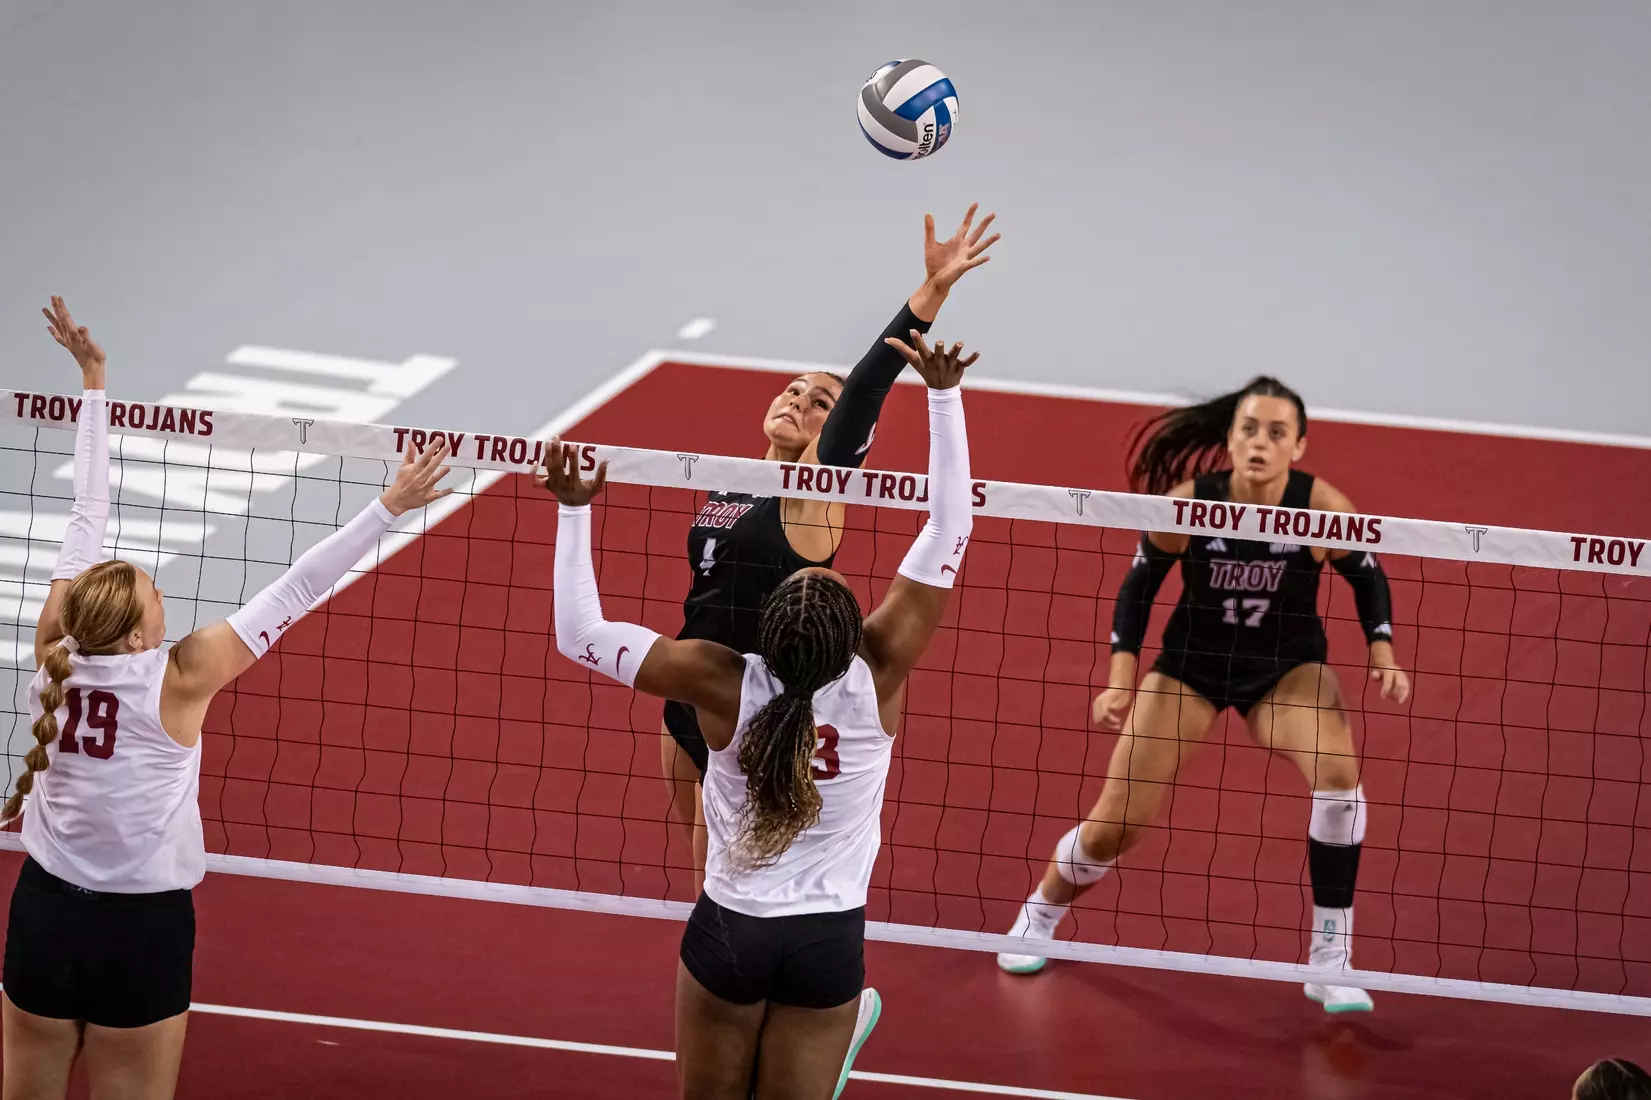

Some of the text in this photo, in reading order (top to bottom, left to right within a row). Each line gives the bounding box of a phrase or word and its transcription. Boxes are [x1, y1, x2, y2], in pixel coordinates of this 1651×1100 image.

[914, 122, 935, 158] olten
[14, 392, 213, 437] TROY ROJANS
[393, 428, 465, 457] TROY
[780, 464, 986, 507] TROY TROJS
[692, 501, 754, 529] TROY
[1173, 500, 1382, 544] TROY TROJANS
[1570, 536, 1646, 567] TROY
[1210, 558, 1287, 592] TROY
[1222, 598, 1271, 628] 17
[59, 688, 119, 760] 19
